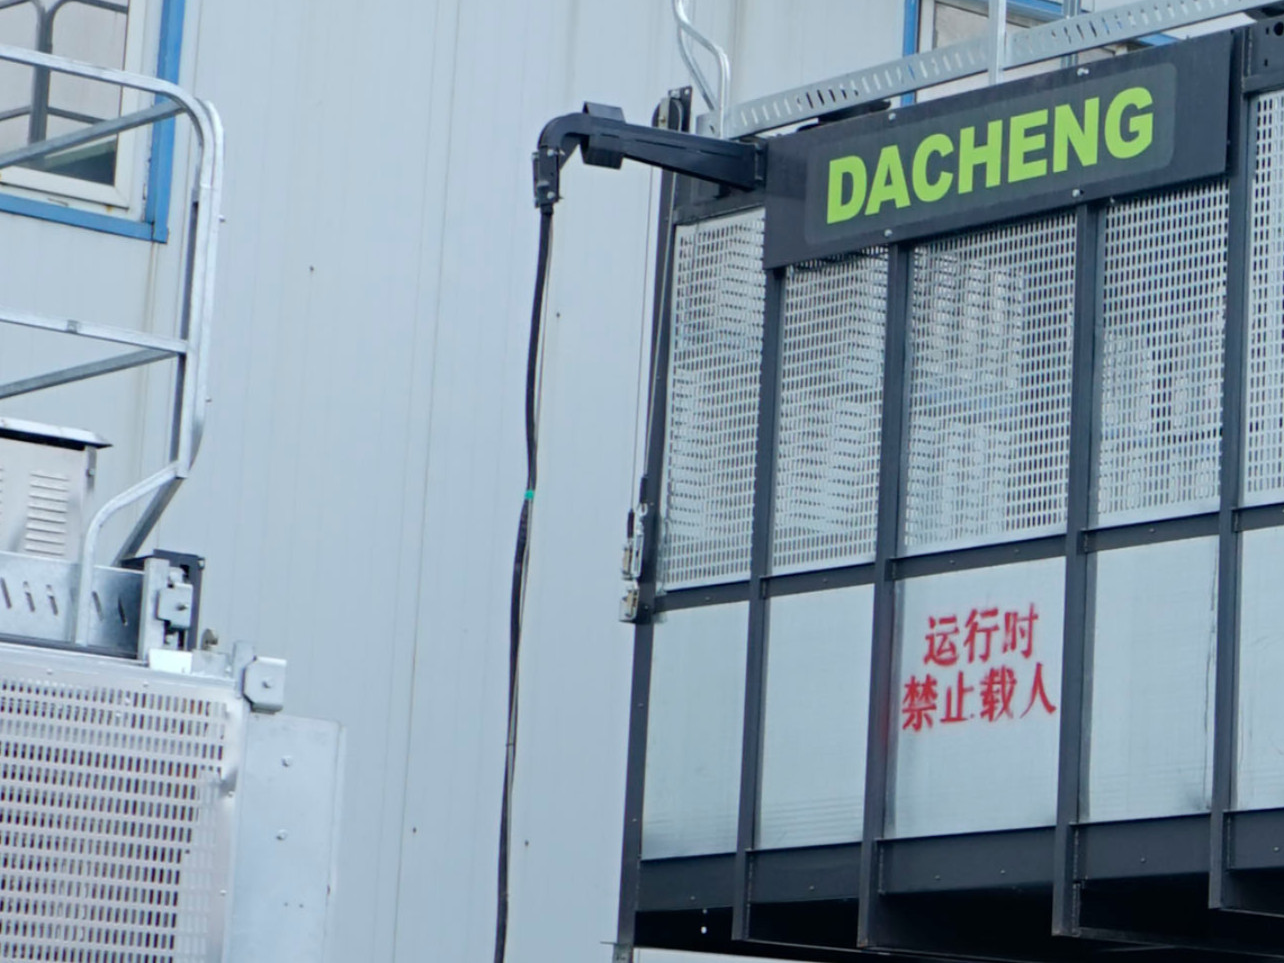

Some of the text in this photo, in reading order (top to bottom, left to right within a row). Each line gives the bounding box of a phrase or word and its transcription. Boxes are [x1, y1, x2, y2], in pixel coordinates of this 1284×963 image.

[826, 86, 1154, 225] DACHENG
[923, 602, 1039, 667] 运行时
[902, 661, 1057, 732] 禁止载人
